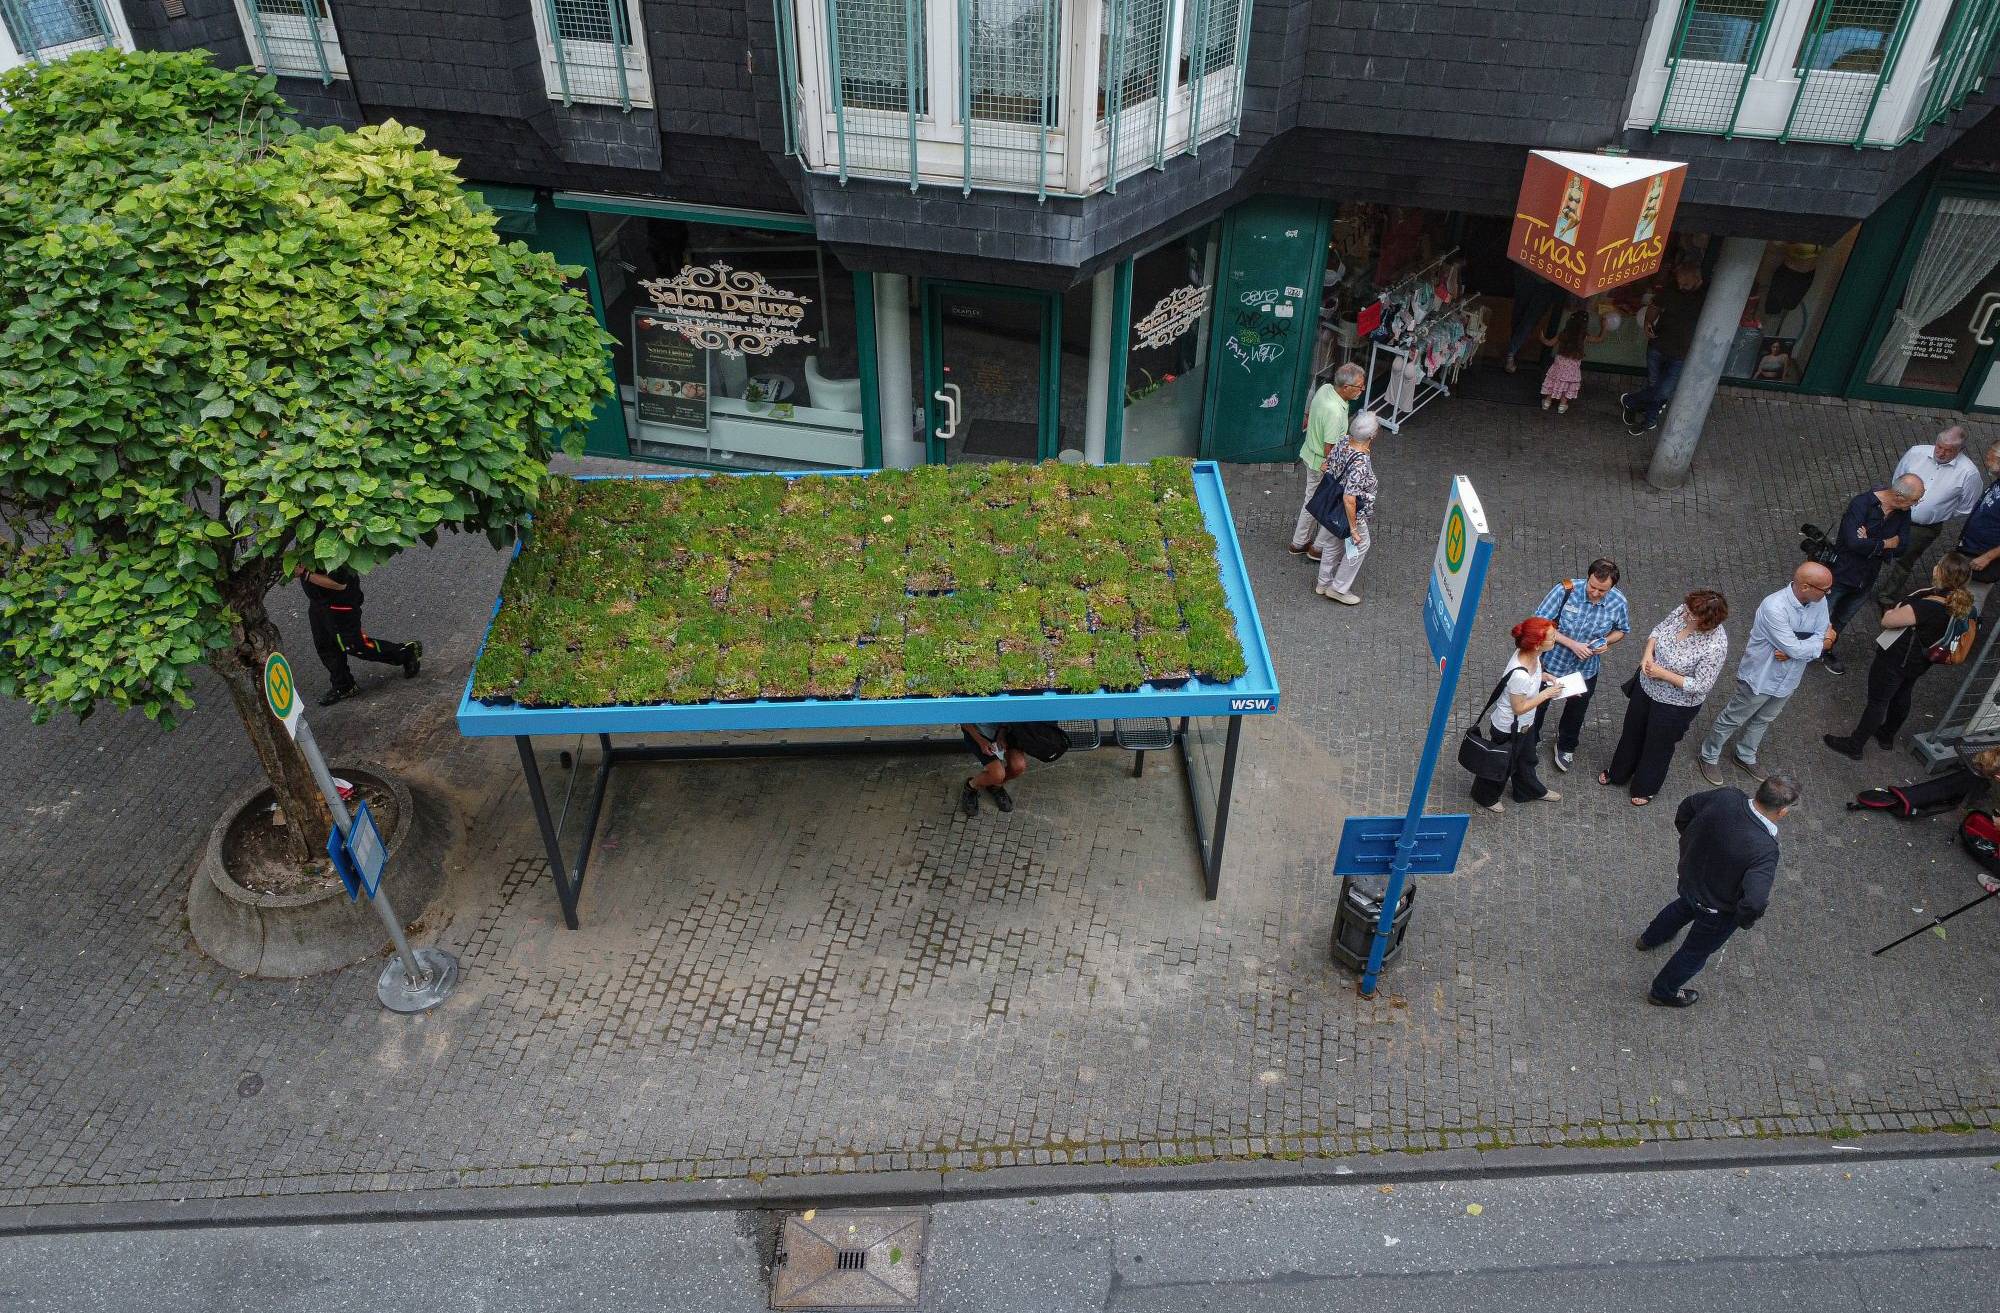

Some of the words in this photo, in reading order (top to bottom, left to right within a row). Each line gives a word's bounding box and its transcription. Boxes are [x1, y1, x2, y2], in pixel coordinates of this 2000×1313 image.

[1516, 213, 1587, 275] Tinas
[1596, 235, 1662, 272] Tinas
[1520, 250, 1581, 288] DESSOUS
[1597, 260, 1657, 288] DESSOUS
[649, 286, 715, 309] Salon
[720, 292, 805, 318] Deluxe
[746, 325, 768, 335] und
[770, 327, 794, 337] Rosi
[1449, 518, 1462, 561] H
[271, 664, 290, 705] H
[1231, 699, 1270, 710] WSW
